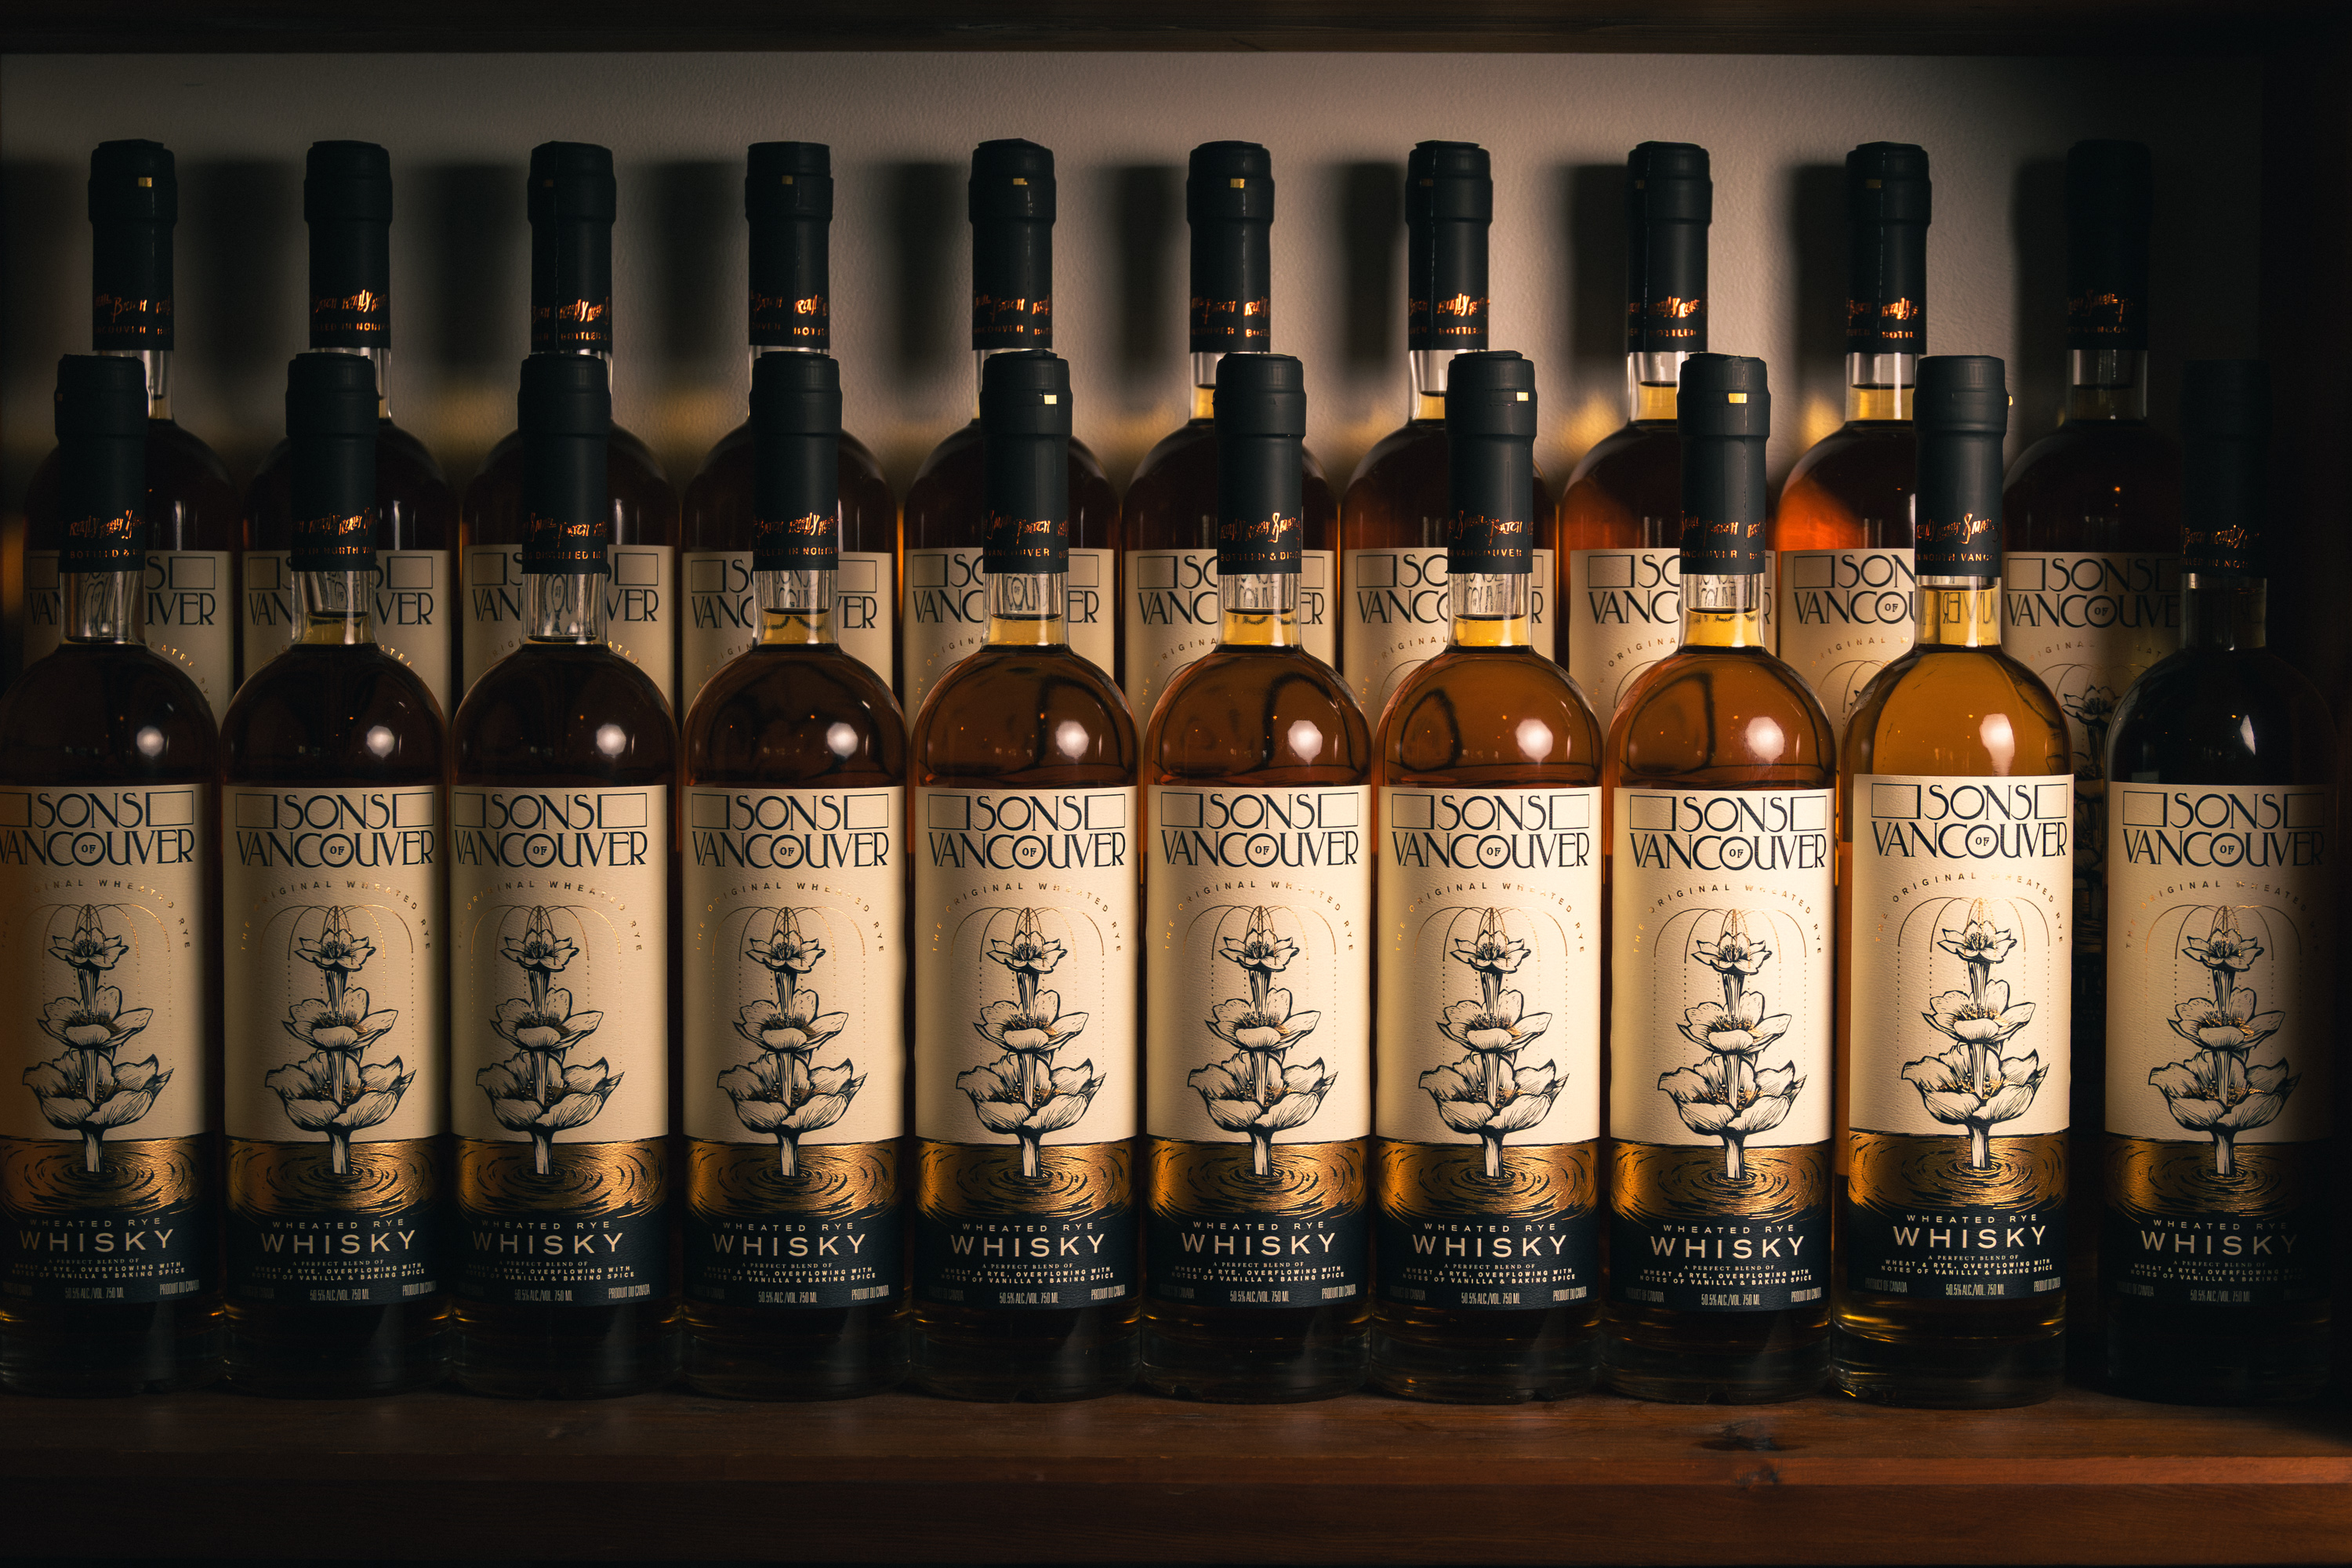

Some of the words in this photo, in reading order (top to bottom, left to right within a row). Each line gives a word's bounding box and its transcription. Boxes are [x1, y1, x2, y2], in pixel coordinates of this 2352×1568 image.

[1837, 554, 1915, 588] SON
[2048, 557, 2154, 593] SONS
[913, 589, 1099, 624] VANCER
[1137, 591, 1324, 626] VANCER
[1884, 603, 1898, 613] OF
[2007, 593, 2181, 629] VANCOUVE
[2095, 606, 2109, 617] OF
[1608, 637, 1676, 667] ORIGINA
[34, 793, 143, 828] SONS
[281, 794, 390, 829] SONS
[488, 794, 594, 829] SONS
[733, 795, 840, 830] SONS
[973, 796, 1082, 831] SONS
[1206, 793, 1315, 829] SONS
[1437, 795, 1546, 830] SONS
[1924, 784, 2032, 820] SONS
[2170, 793, 2281, 829] SONS
[1679, 797, 1788, 832] SONS
[0, 829, 194, 866] VANCOUVER
[82, 844, 96, 854] OF
[237, 830, 434, 868] VANCOUVER
[330, 846, 345, 855] OF
[455, 830, 647, 868] VANCOUVER
[532, 845, 547, 855] OF
[692, 831, 888, 869] VANCOUVER
[780, 847, 794, 856] OF
[928, 832, 1125, 869] VANCOUVER
[1161, 830, 1358, 868] VANCOUVER
[1255, 845, 1269, 855] OF
[1392, 832, 1589, 869] VANCOUVER
[1630, 833, 1826, 870] VANCOUVER
[1871, 822, 2067, 858] VANCOUVER
[1976, 837, 1989, 846] OF
[2123, 829, 2325, 867] VANCOUVER
[2220, 845, 2234, 855] OF
[1022, 848, 1036, 857] OF
[1486, 848, 1501, 856] OF
[1730, 848, 1744, 858] OF
[1649, 884, 1730, 913] ORIGINAL
[1893, 872, 1976, 903] ORIGINAL
[946, 883, 1022, 913] ORIGINAL
[1111, 921, 1121, 952] RYE
[1178, 881, 1255, 911] ORIGINAL
[1344, 920, 1353, 950] RYE
[1410, 883, 1486, 913] ORIGINAL
[1575, 922, 1584, 953] RYE
[873, 921, 884, 952] RYE
[129, 1218, 160, 1226] RYE
[374, 1219, 404, 1228] RYE
[482, 1220, 561, 1229] WHEATED
[723, 1222, 805, 1232] WHEATED
[963, 1223, 1047, 1232] WHEATED
[1193, 1221, 1278, 1230] WHEATED
[1425, 1223, 1509, 1232] WHEATED
[1664, 1225, 1750, 1234] WHEATED
[1766, 1225, 1794, 1233] RYE
[1907, 1214, 1994, 1223] WHEATED
[2154, 1220, 2240, 1230] WHEATED
[20, 1229, 173, 1252] WHISKY
[261, 1230, 415, 1254] WHISKY
[473, 1231, 622, 1254] WHISKY
[713, 1233, 866, 1256] WHISKY
[950, 1234, 1104, 1257] WHISKY
[1181, 1232, 1335, 1255] WHISKY
[1413, 1235, 1566, 1258] WHISKY
[1650, 1236, 1804, 1258] WHISKY
[1893, 1226, 2045, 1248] WHISKY
[2141, 1230, 2297, 1255] WHISKY
[869, 1287, 875, 1299] DU
[1883, 1280, 1889, 1290] OF
[1987, 1283, 1996, 1295] 750
[1998, 1283, 2005, 1294] ML
[1743, 1294, 1751, 1305] 750
[1753, 1294, 1760, 1305] ML
